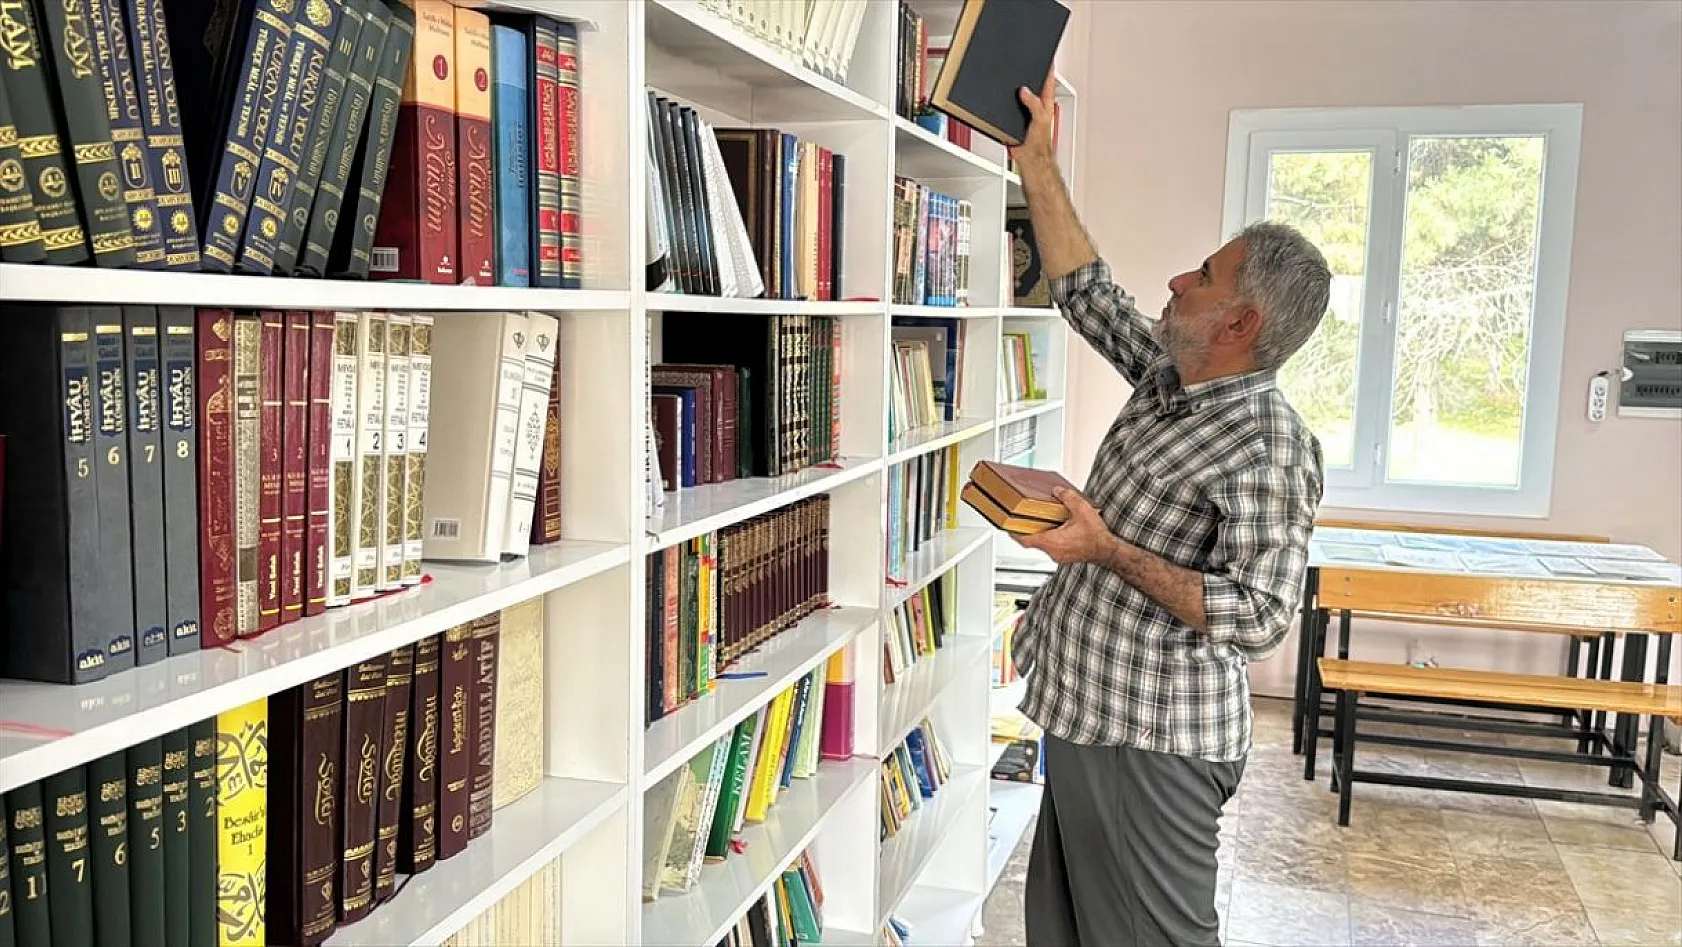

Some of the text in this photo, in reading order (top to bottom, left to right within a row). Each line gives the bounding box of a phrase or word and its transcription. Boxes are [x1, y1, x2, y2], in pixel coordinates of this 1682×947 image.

[121, 69, 139, 120] YOLU
[163, 77, 180, 128] YOLU
[252, 106, 272, 150] YOLU
[289, 115, 308, 157] YOLU
[426, 115, 446, 232] Müslim
[346, 438, 351, 456] 1
[372, 431, 381, 450] 2
[397, 432, 404, 450] 3
[419, 431, 426, 446] 4
[108, 446, 119, 464] 6
[144, 445, 155, 463] 7
[176, 440, 188, 458] 8
[78, 458, 88, 477] 5
[79, 653, 105, 669] akit
[177, 810, 187, 832] 3
[150, 826, 160, 850] 5
[114, 842, 126, 865] 6
[71, 859, 86, 883] 7
